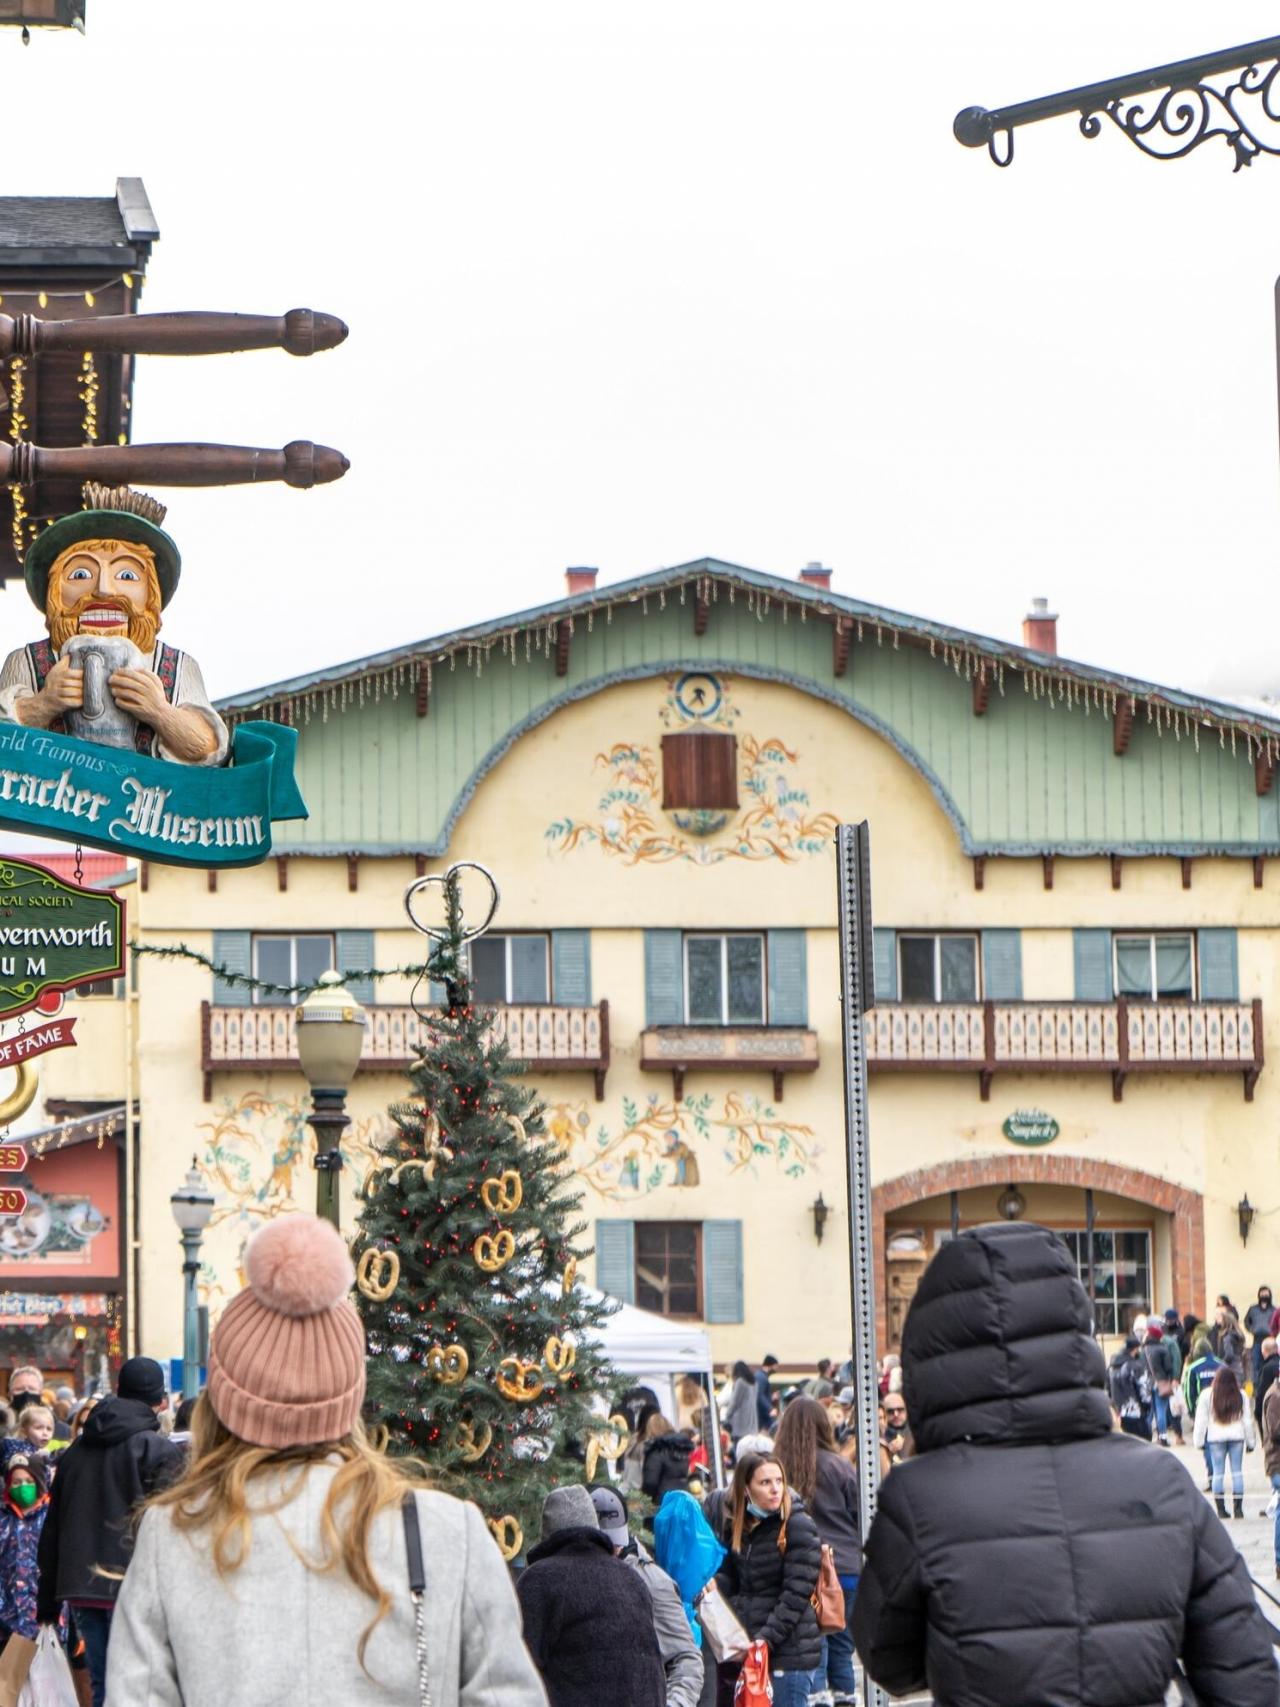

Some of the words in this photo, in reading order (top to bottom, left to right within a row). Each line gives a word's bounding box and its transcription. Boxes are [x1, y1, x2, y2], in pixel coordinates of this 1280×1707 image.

[31, 737, 107, 773] Famous
[109, 778, 266, 848] Museum
[28, 895, 74, 907] SOCIETY
[15, 1026, 63, 1056] FAME
